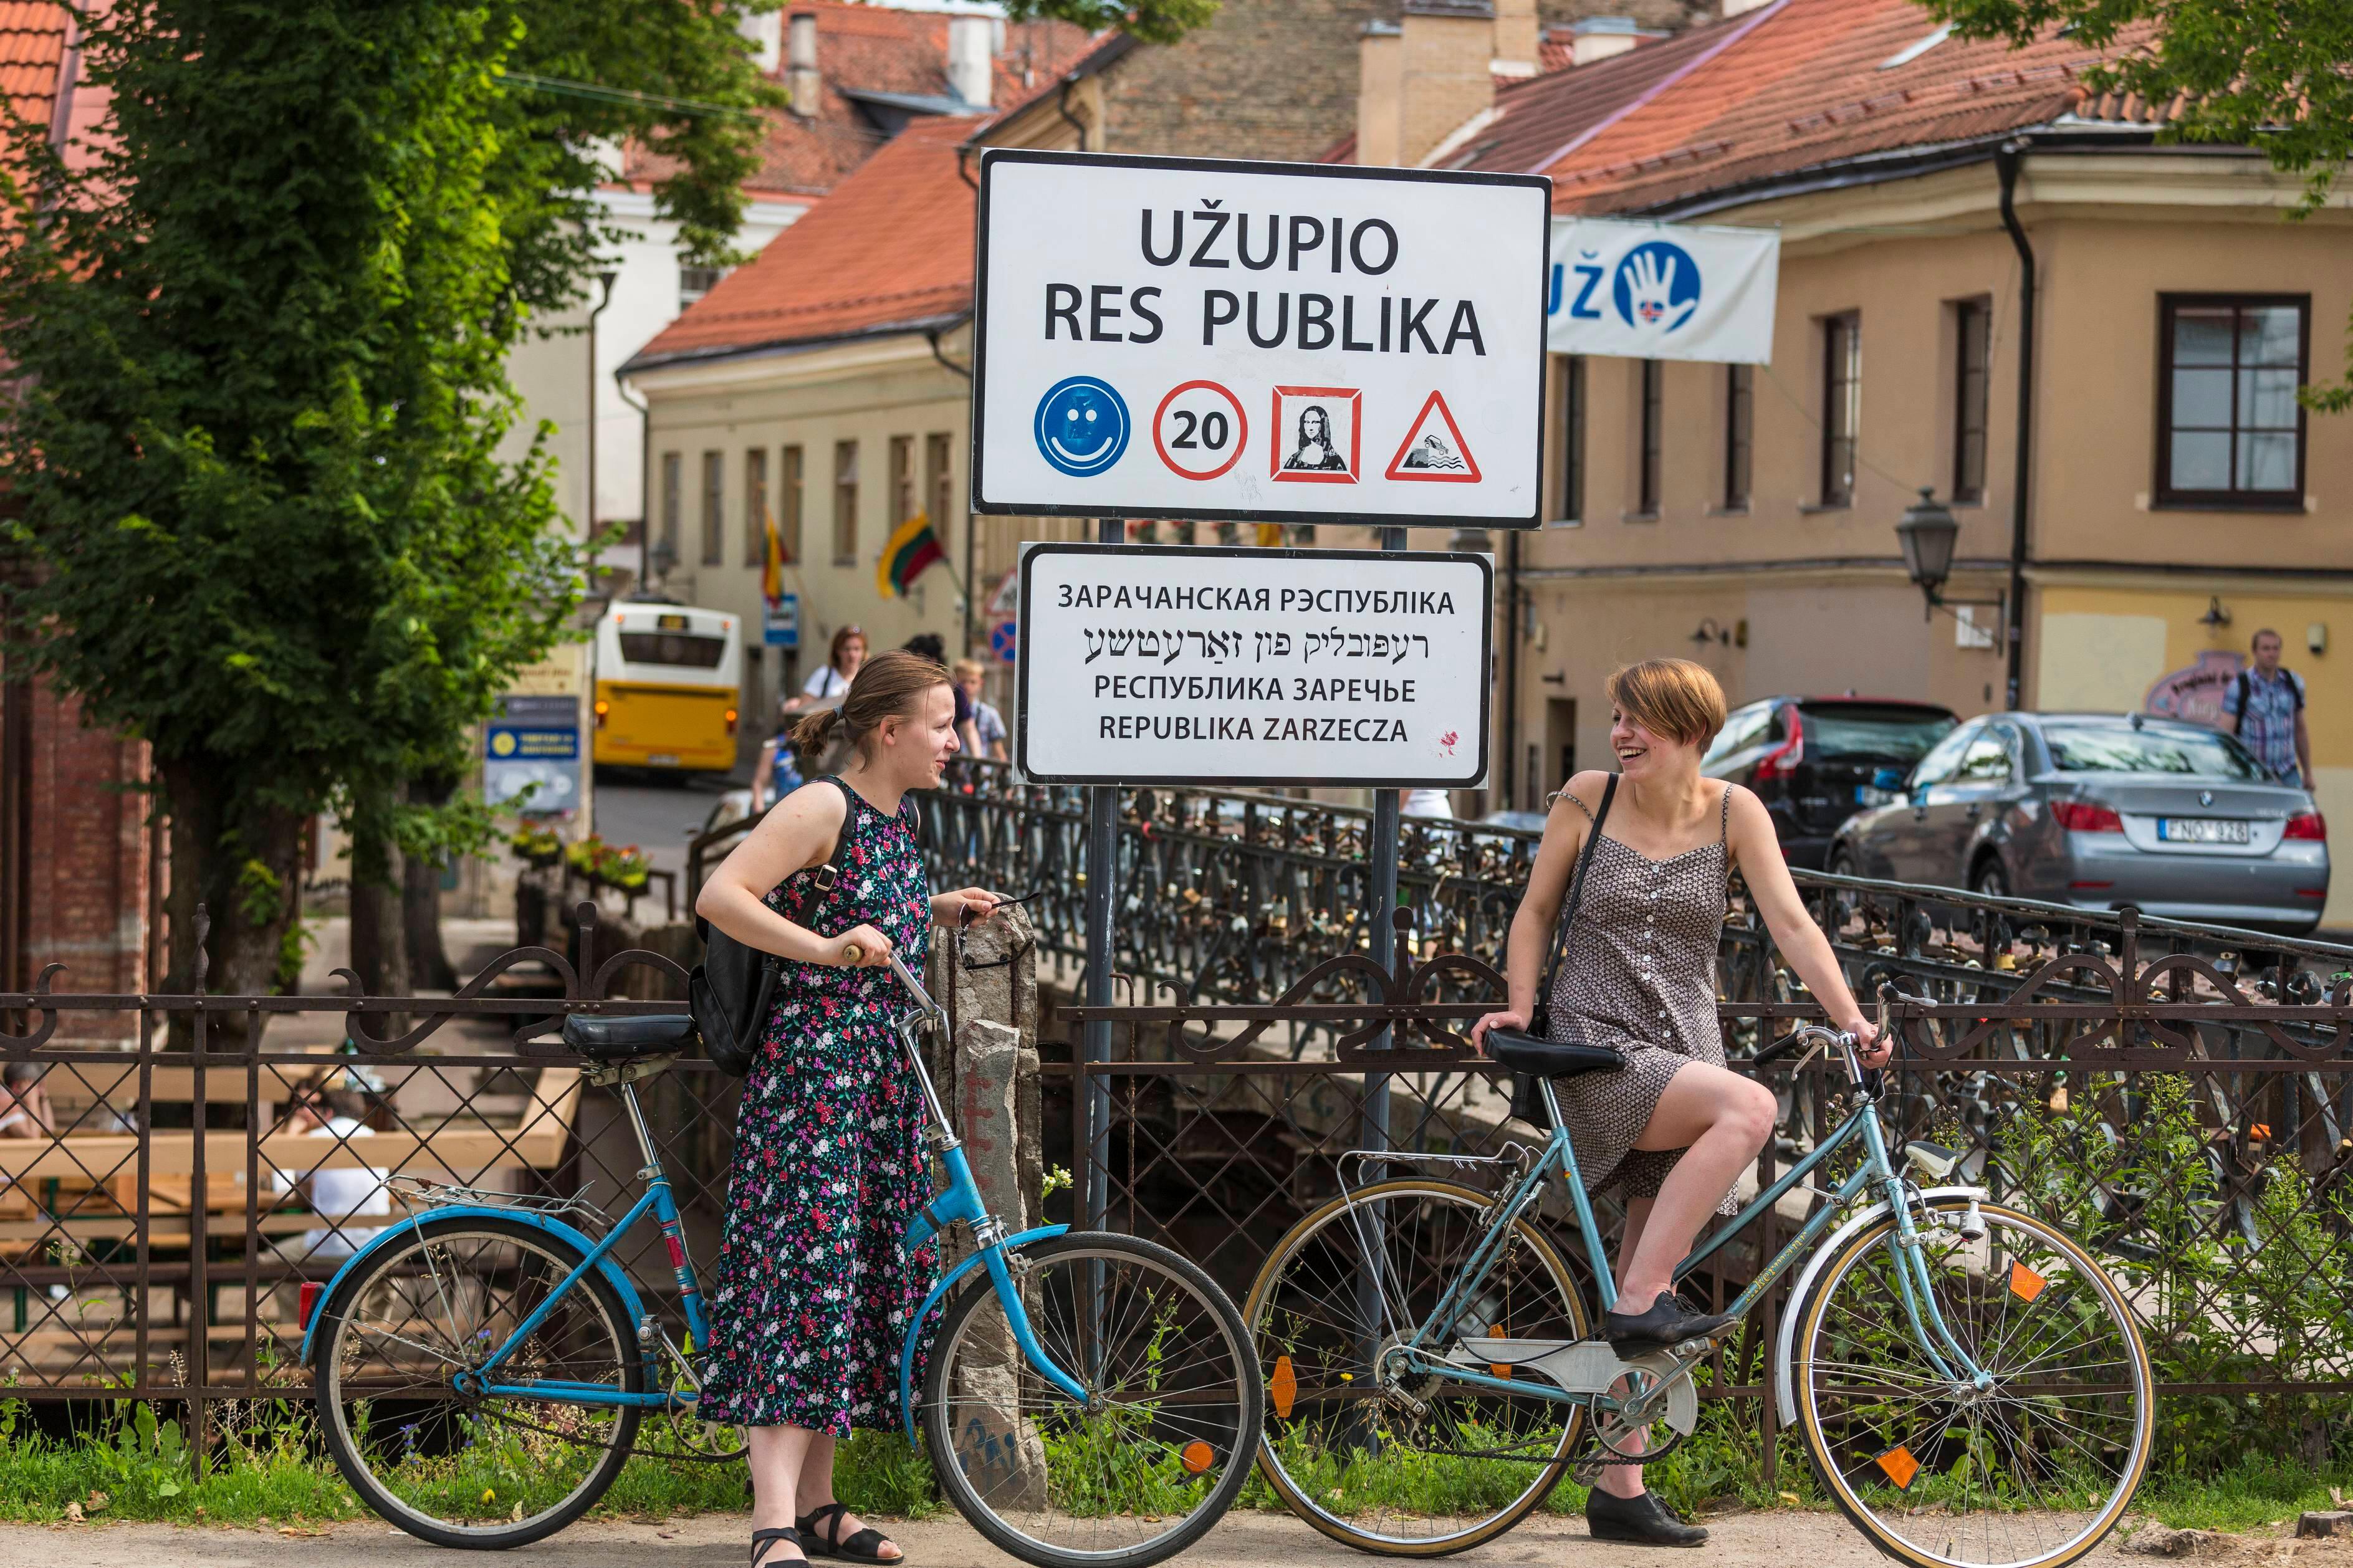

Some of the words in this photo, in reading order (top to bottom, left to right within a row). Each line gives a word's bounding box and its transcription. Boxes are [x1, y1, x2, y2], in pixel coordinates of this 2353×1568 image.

[1141, 198, 1399, 275] UŽUPIO
[1045, 283, 1164, 344] RES
[1203, 289, 1487, 356] PUBLIKA
[1171, 410, 1229, 450] 20
[1058, 584, 1270, 611] ЗАРАЧАНСКАЯ
[1281, 588, 1455, 614] РЭСПУБЛІКА
[1254, 631, 1291, 664] פון
[1095, 675, 1284, 700] РЕСПУБЛИКА
[1293, 677, 1415, 702] ЗАРЕЧЬЕ
[1100, 715, 1254, 740] REPUBLIKA
[1263, 717, 1408, 742] ZARZECZA
